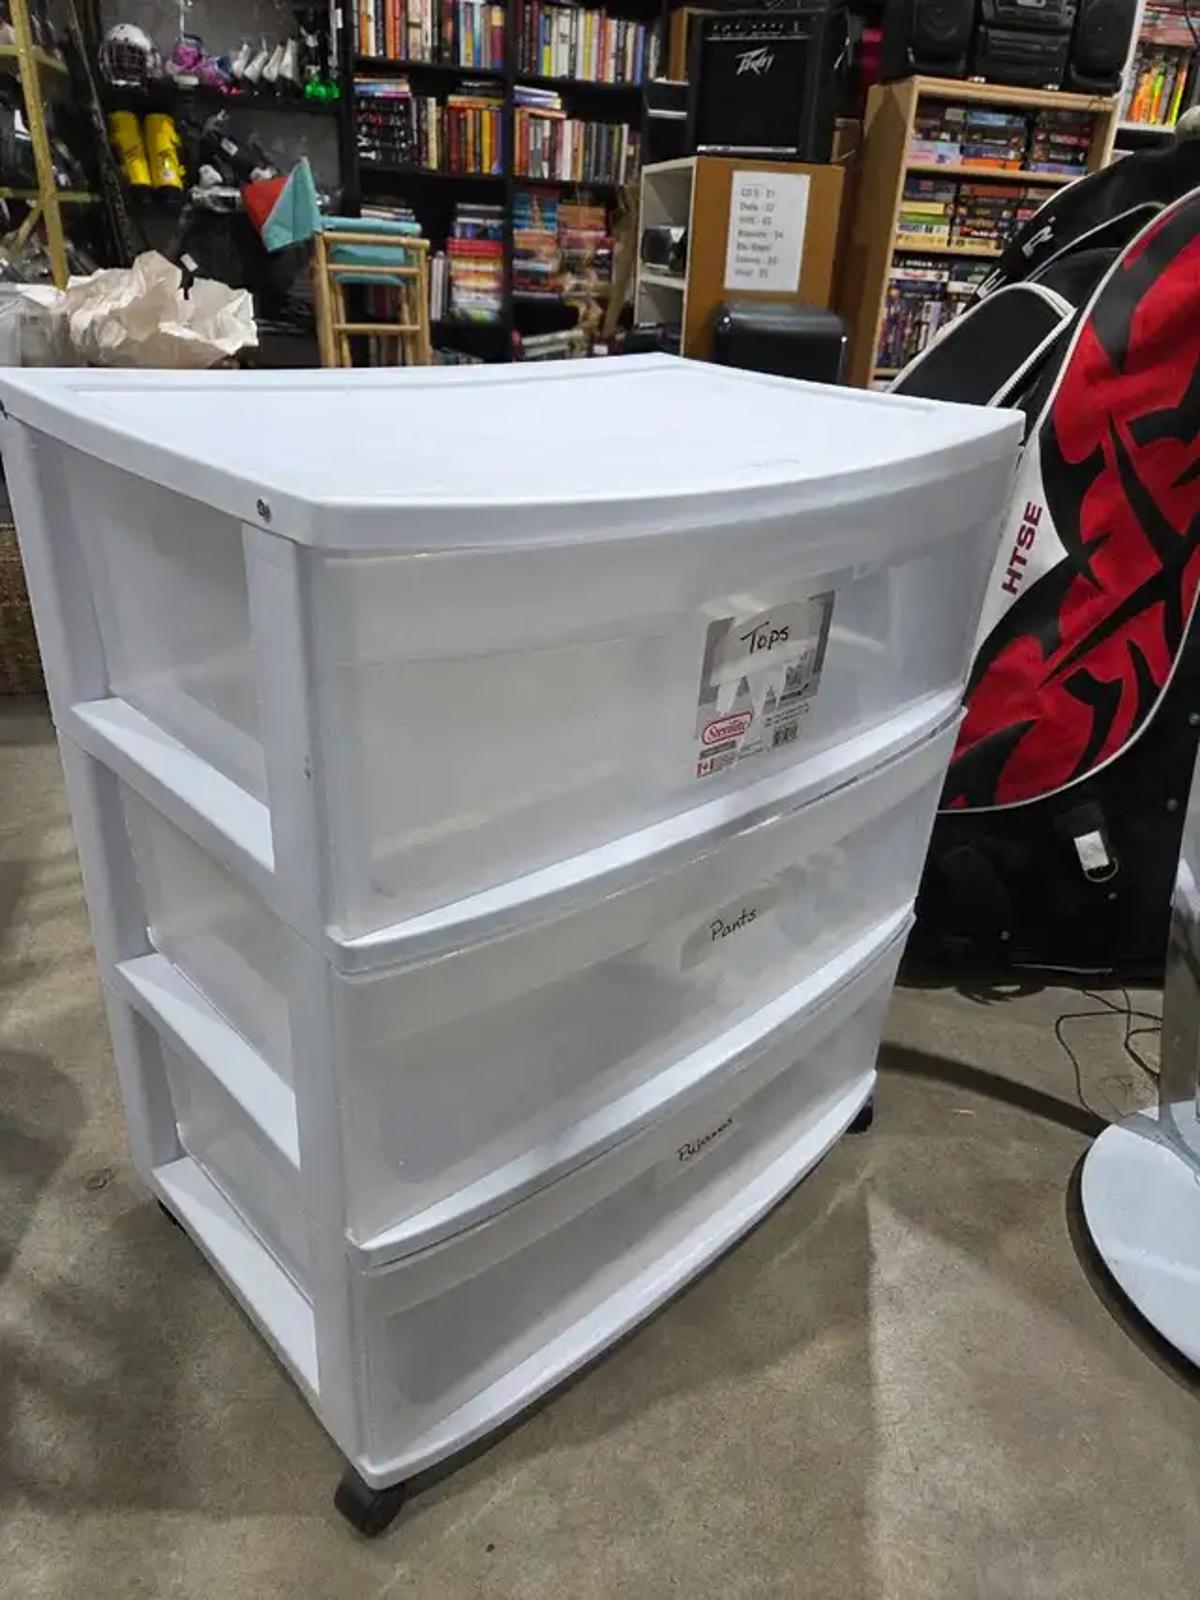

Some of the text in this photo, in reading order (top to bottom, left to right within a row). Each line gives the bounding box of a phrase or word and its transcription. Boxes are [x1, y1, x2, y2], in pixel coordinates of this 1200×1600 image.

[1001, 501, 1042, 595] HTSE
[740, 620, 790, 653] Tops
[710, 908, 757, 941] Pants
